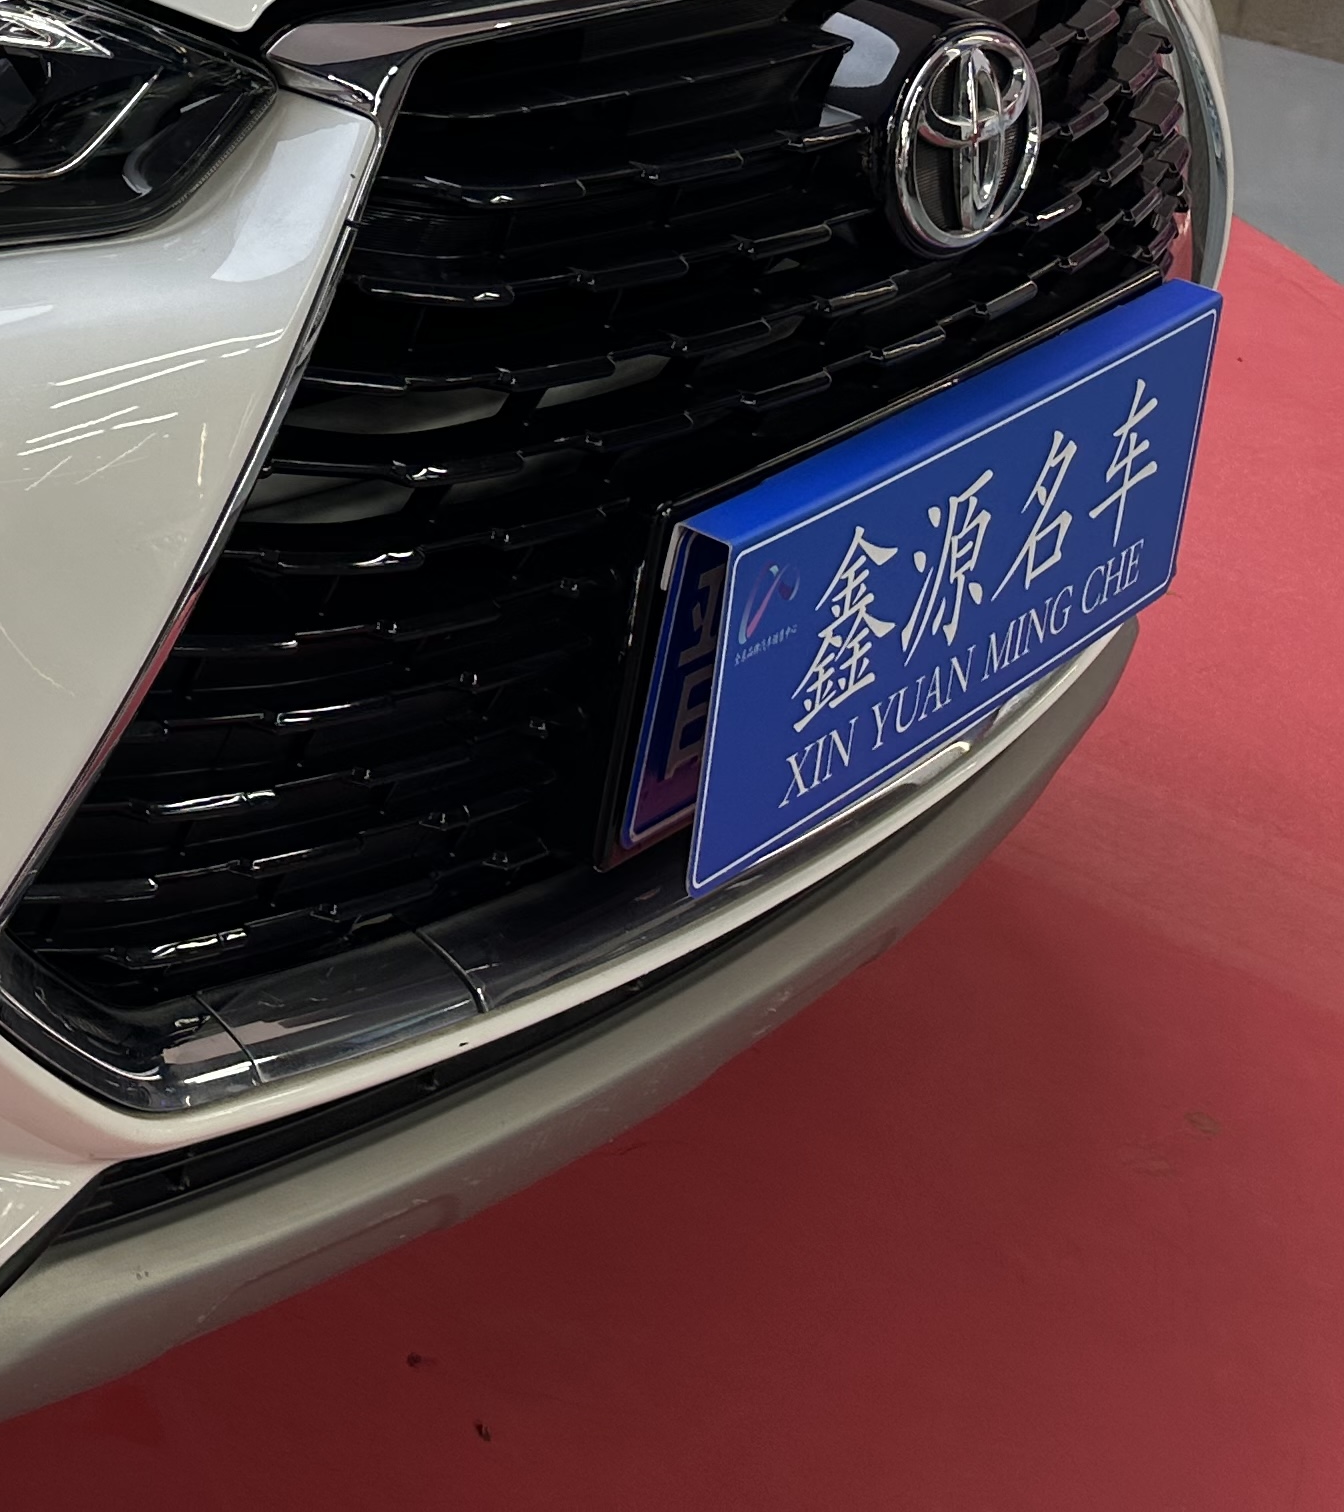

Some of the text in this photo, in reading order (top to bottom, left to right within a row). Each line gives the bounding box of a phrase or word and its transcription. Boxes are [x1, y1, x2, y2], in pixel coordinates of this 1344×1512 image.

[778, 539, 1145, 808] XIN YUAN MING CHE
[791, 378, 1159, 733] 鑫源名车
